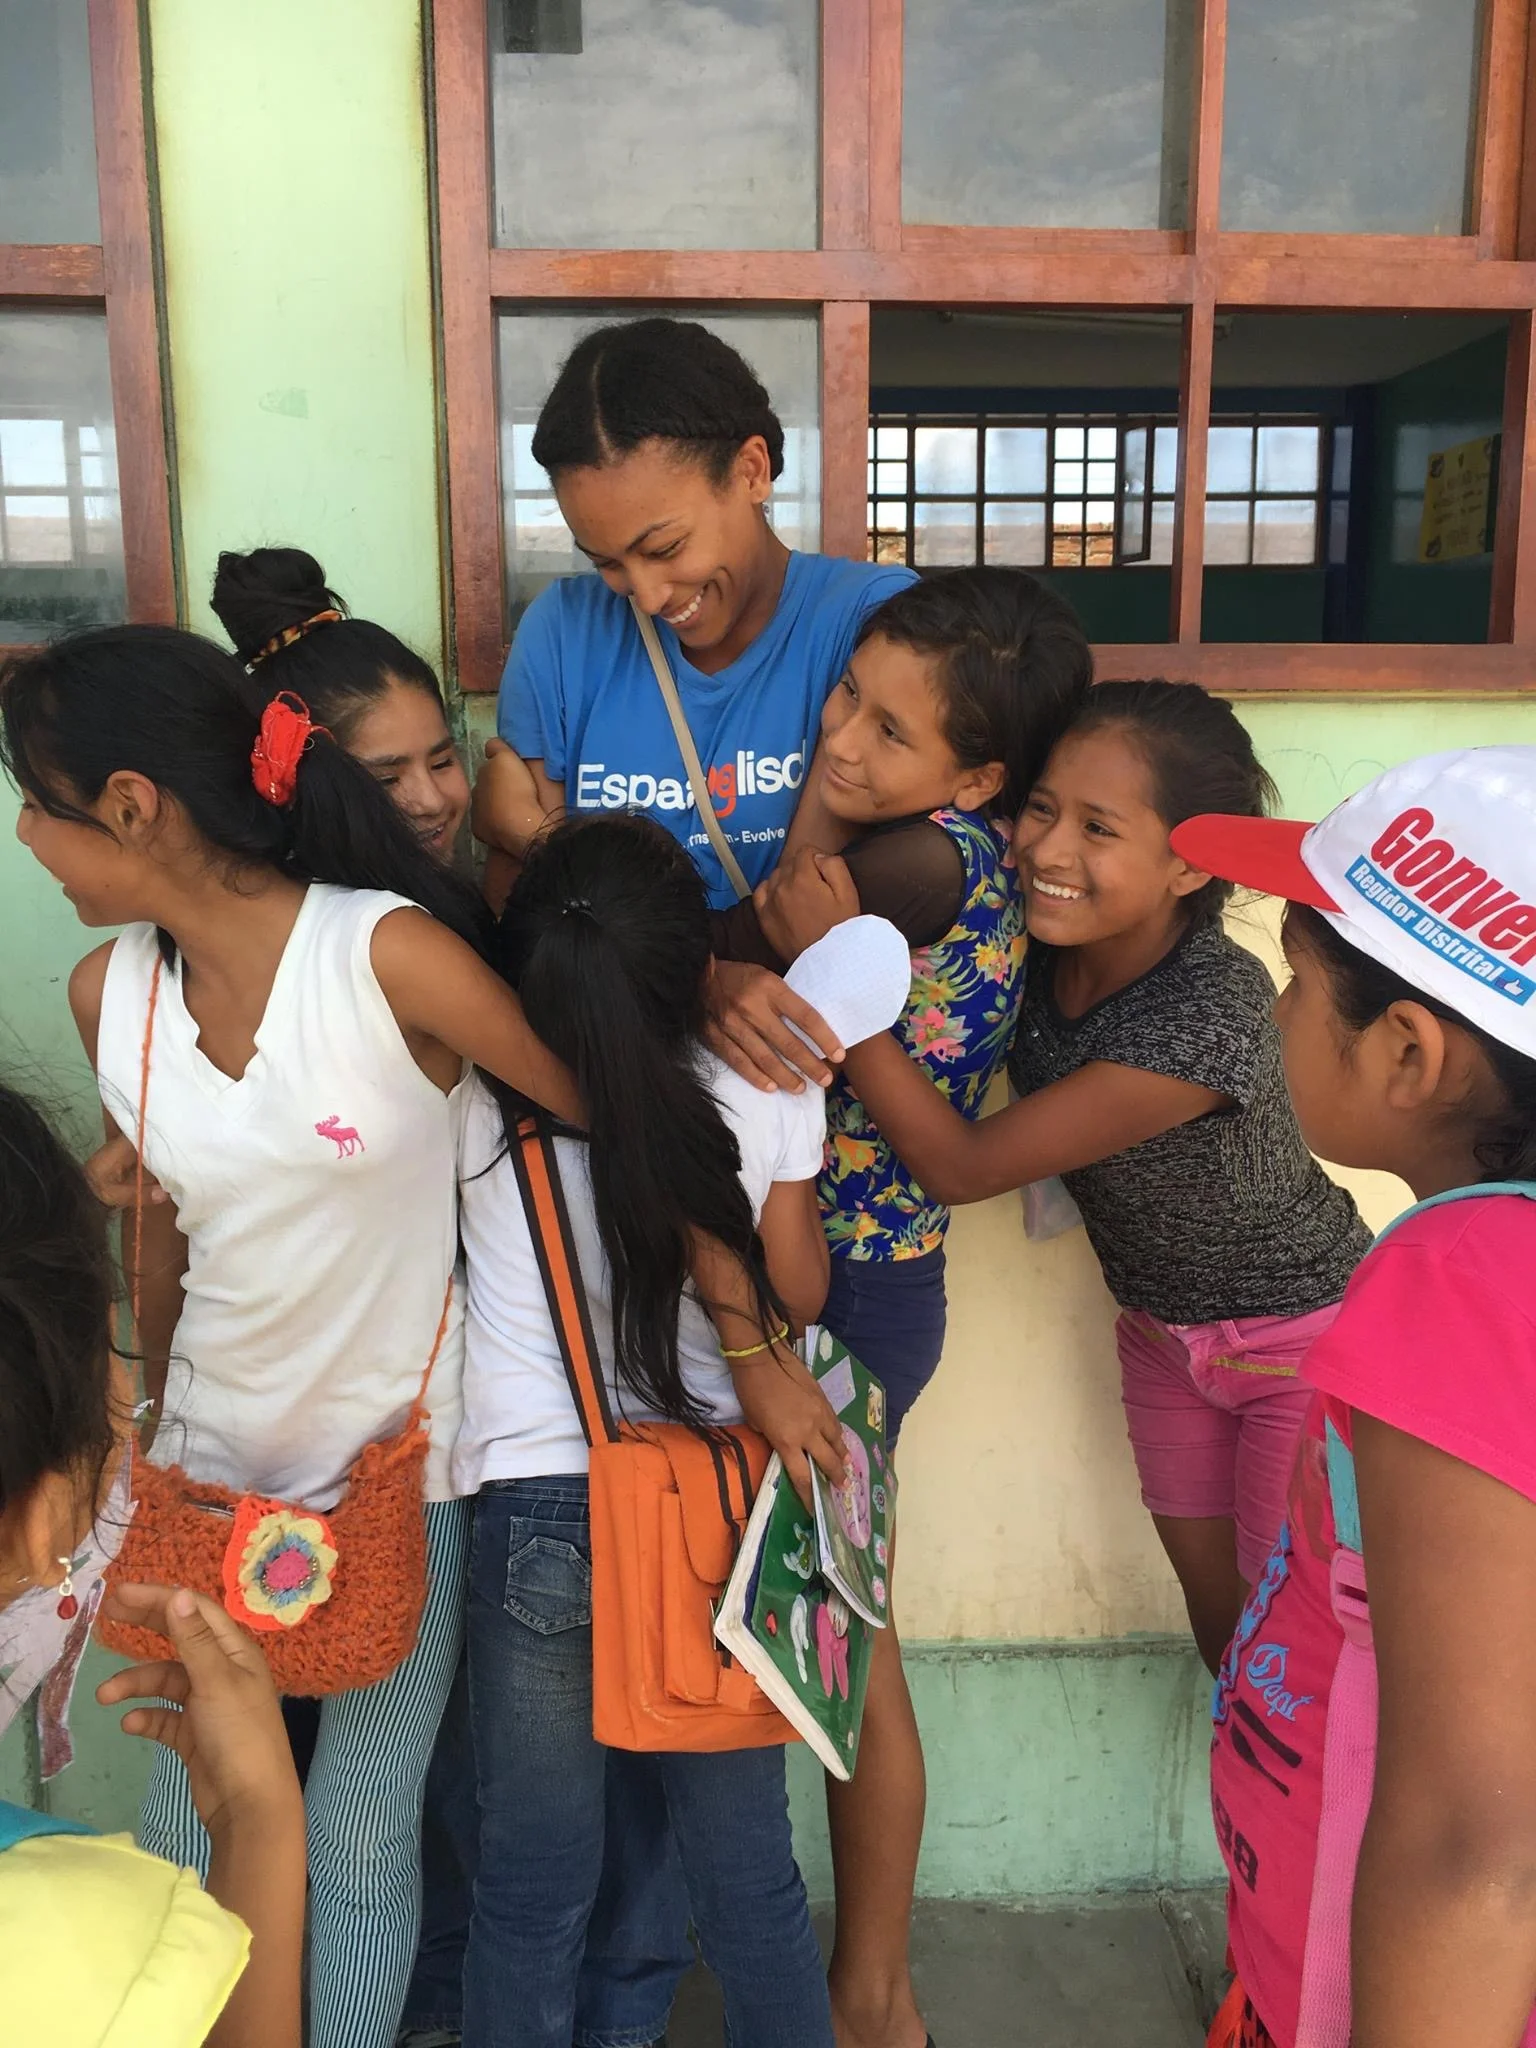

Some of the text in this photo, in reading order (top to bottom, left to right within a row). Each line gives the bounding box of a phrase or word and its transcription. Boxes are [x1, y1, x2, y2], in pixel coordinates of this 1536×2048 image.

[742, 826, 786, 844] Evolve
[1350, 863, 1505, 981] Regidor Distrital
